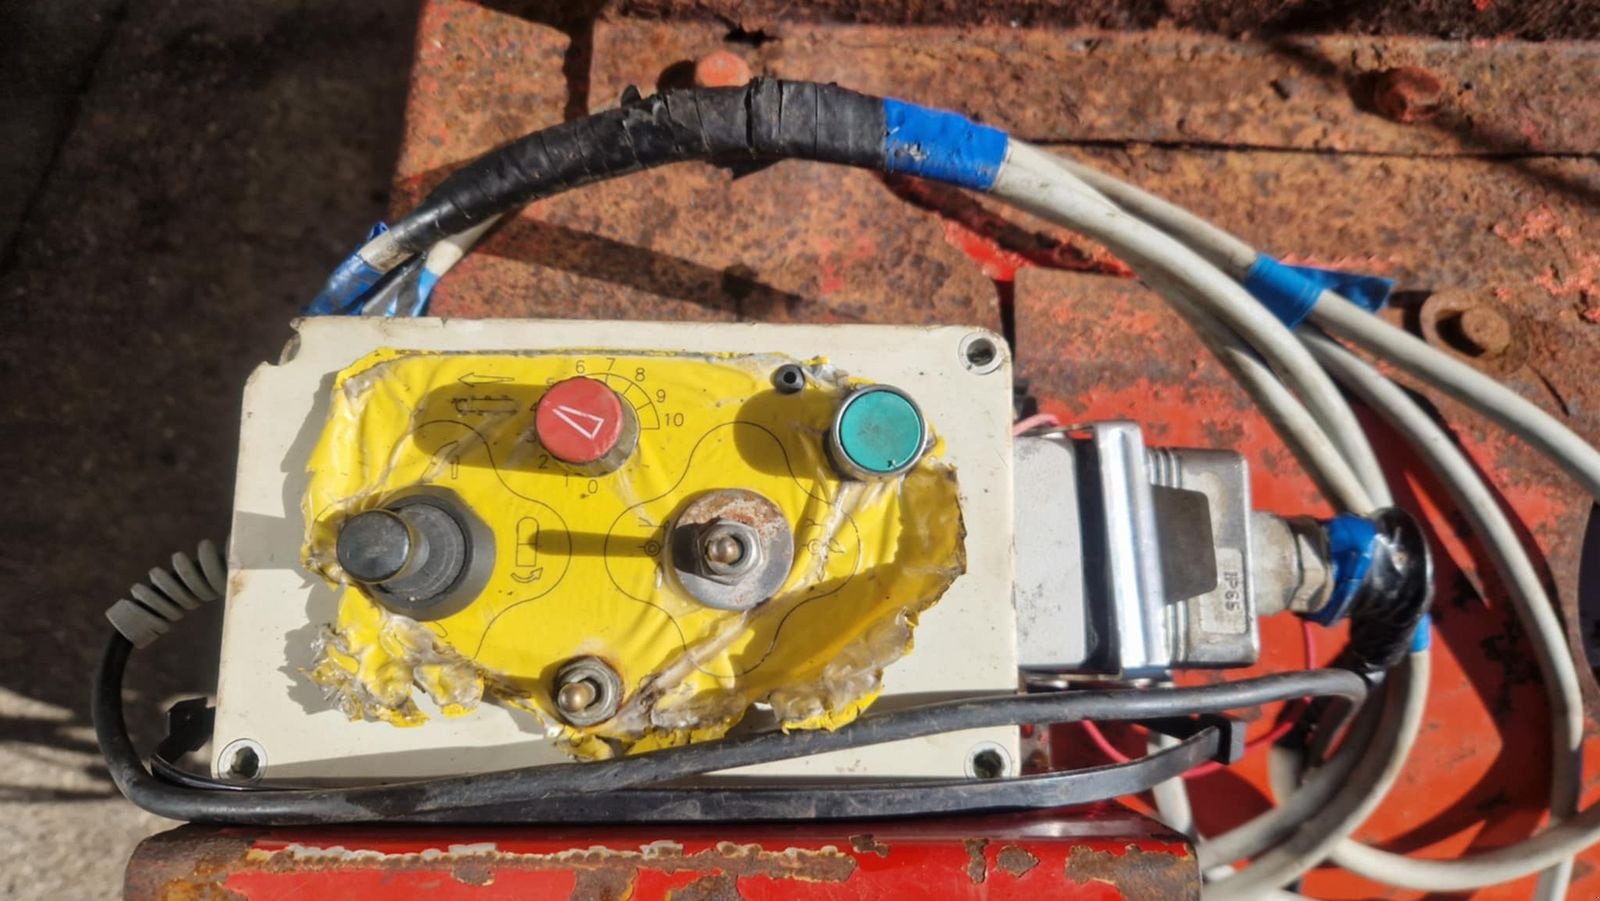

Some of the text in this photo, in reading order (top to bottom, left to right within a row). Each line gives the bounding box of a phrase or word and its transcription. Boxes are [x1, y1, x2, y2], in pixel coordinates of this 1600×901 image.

[575, 359, 585, 374] 6
[605, 357, 616, 372] 7
[635, 367, 646, 382] 8
[655, 388, 666, 403] 9
[664, 412, 685, 427] 10
[537, 454, 549, 469] 2
[587, 478, 599, 494] 0
[1223, 571, 1241, 611] IP65
